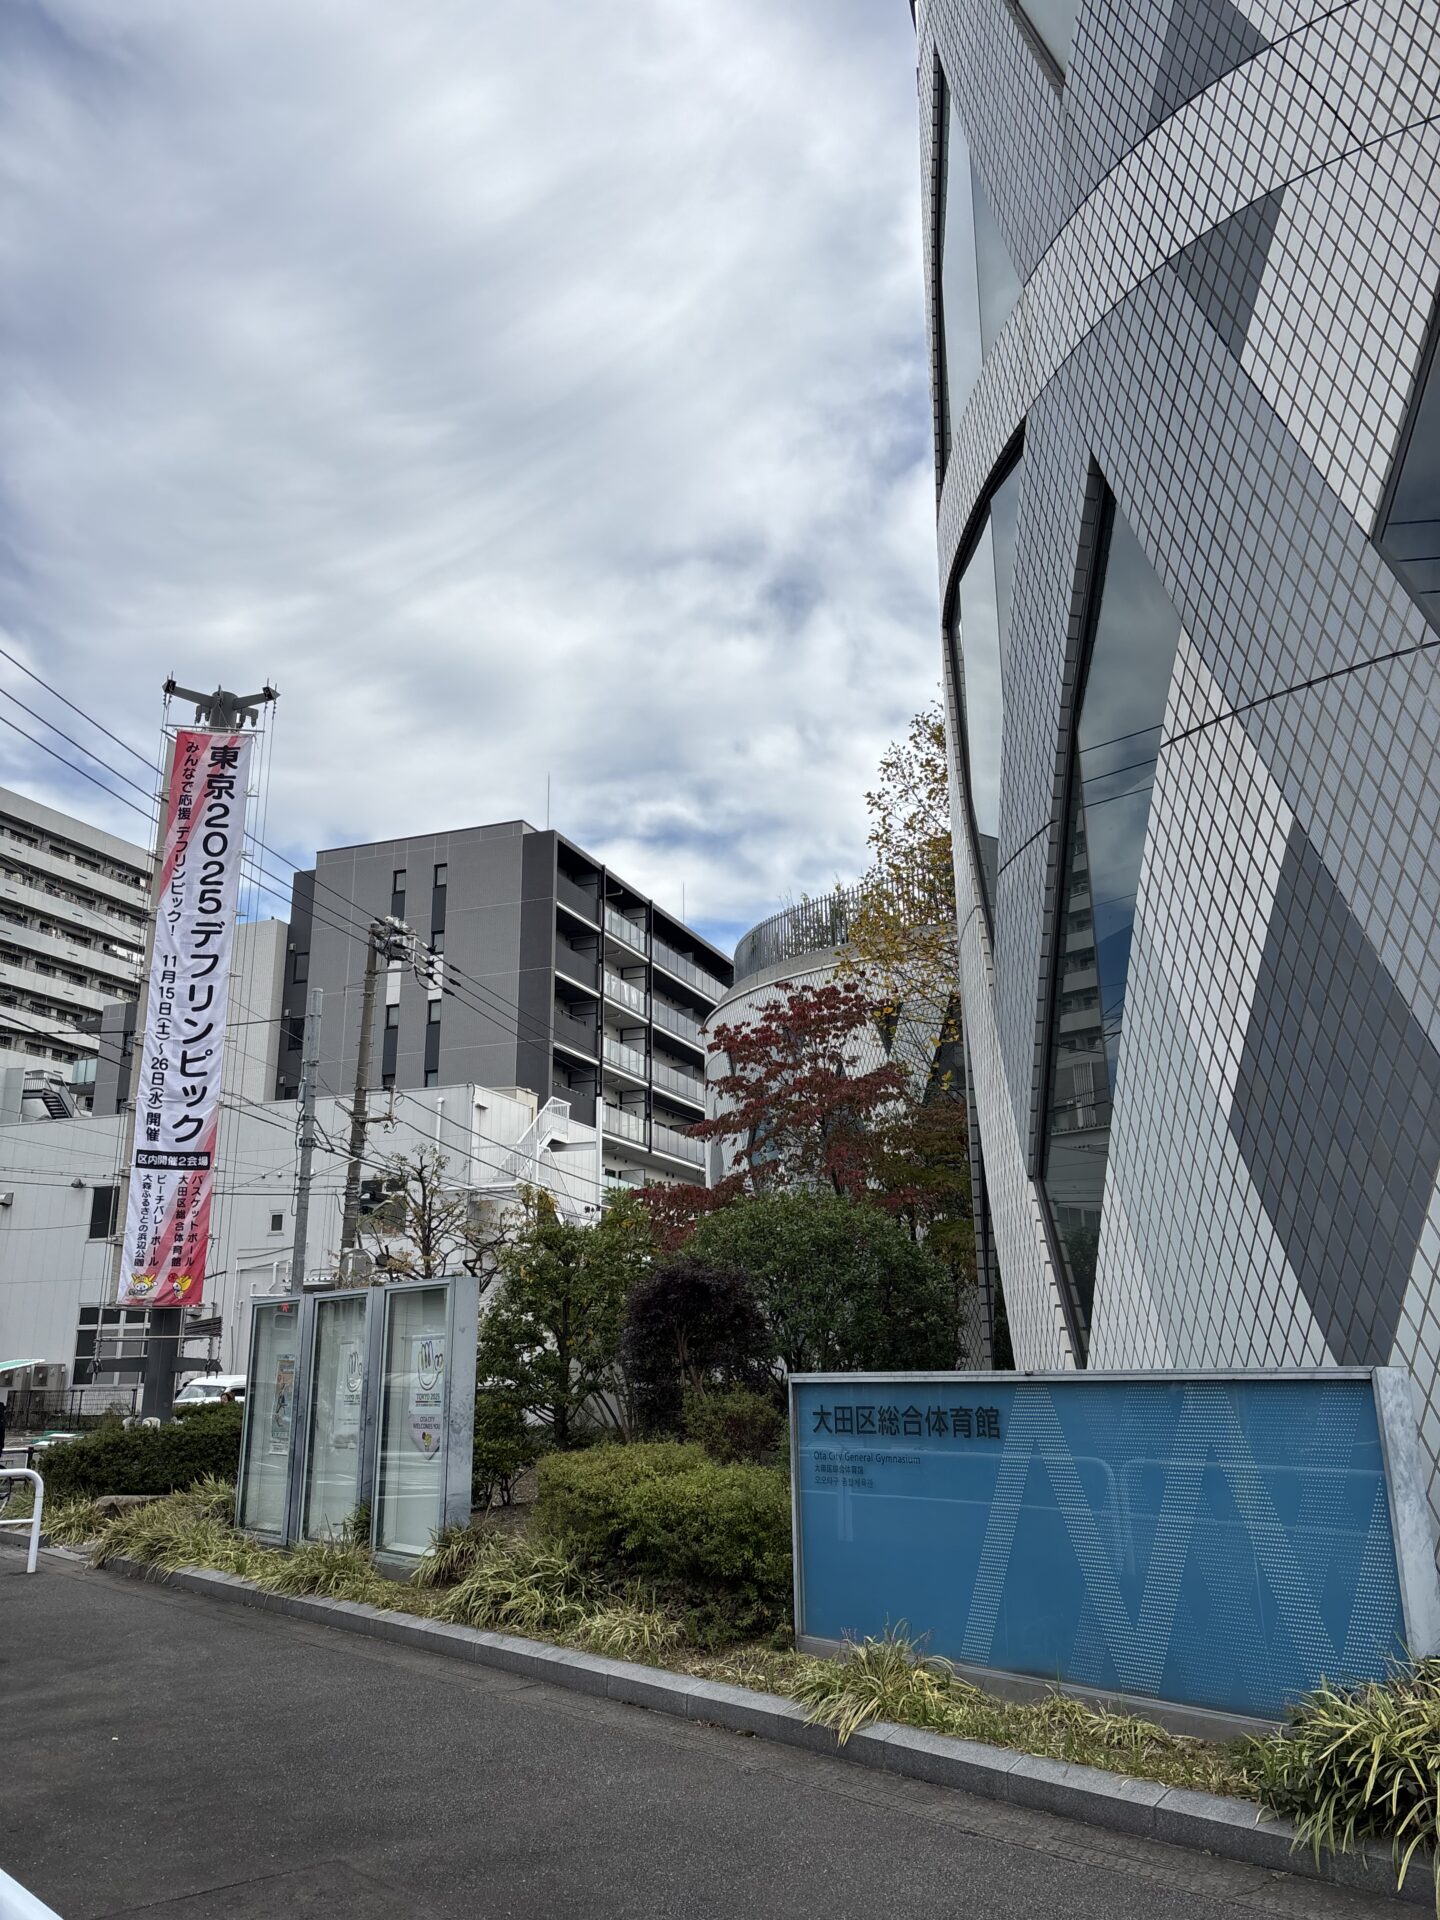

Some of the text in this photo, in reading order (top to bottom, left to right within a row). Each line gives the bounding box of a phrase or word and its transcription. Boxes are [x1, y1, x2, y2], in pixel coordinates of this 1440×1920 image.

[177, 740, 200, 821] みんなで応援
[172, 744, 241, 1143] 東京2025デフリンピック
[138, 1155, 209, 1168] 区内開催2会場
[134, 1174, 153, 1266] 大森ふるさとの浜辺公園
[148, 1174, 168, 1267] ビーチバレーボール
[171, 1175, 189, 1267] 大田区総合体育館
[184, 1175, 204, 1267] バスケットボール
[812, 1405, 1001, 1440] 大田区総合体育館
[814, 1451, 921, 1466] Ota City General Gymnasium
